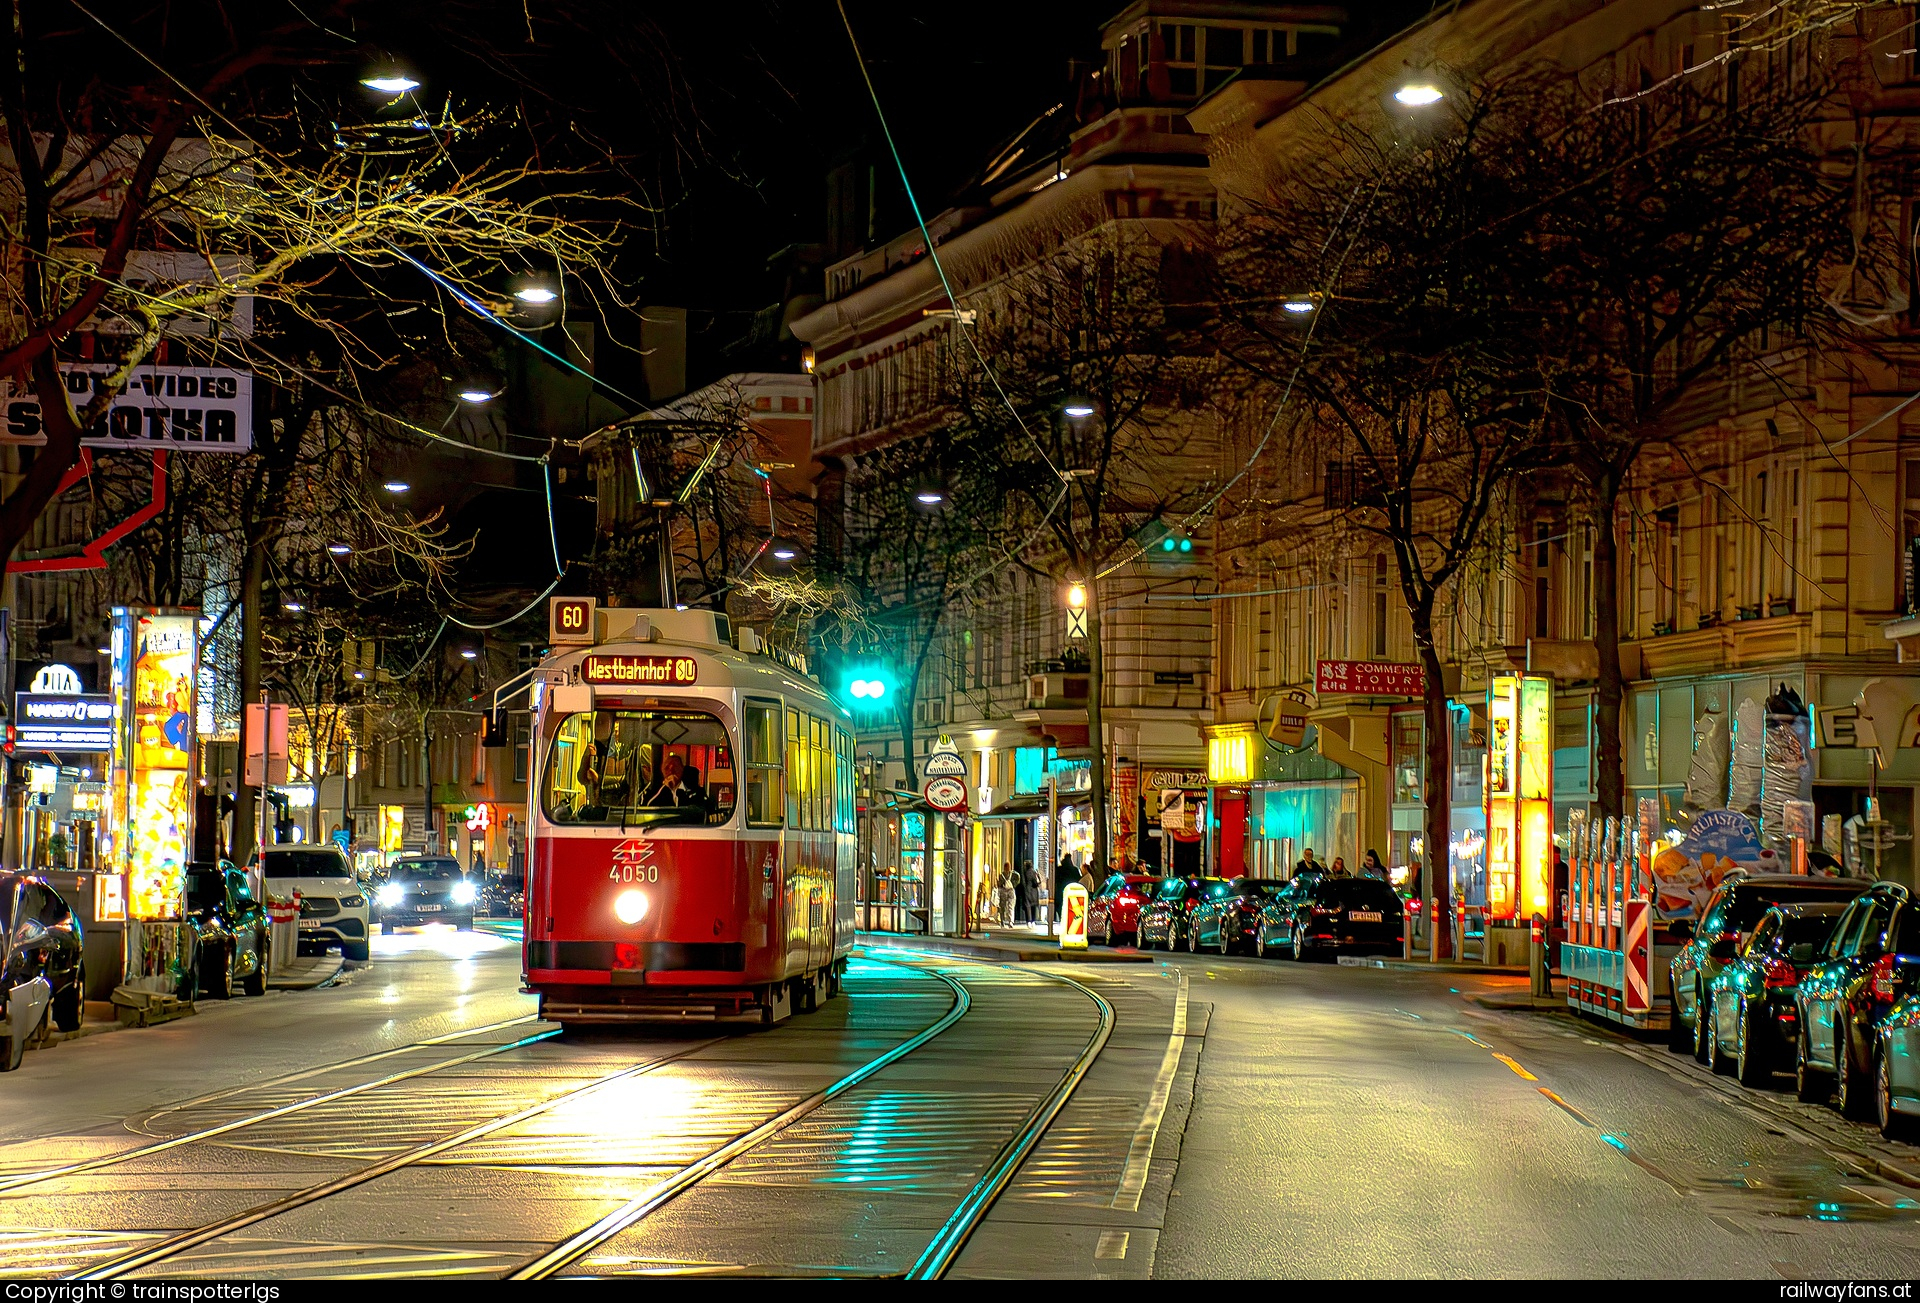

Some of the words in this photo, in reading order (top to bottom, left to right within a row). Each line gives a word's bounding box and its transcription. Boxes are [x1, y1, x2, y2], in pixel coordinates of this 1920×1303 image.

[8, 402, 236, 442] SBOTKA
[563, 606, 582, 628] 60
[588, 657, 672, 680] Westbahnhof
[609, 864, 659, 884] 4050
